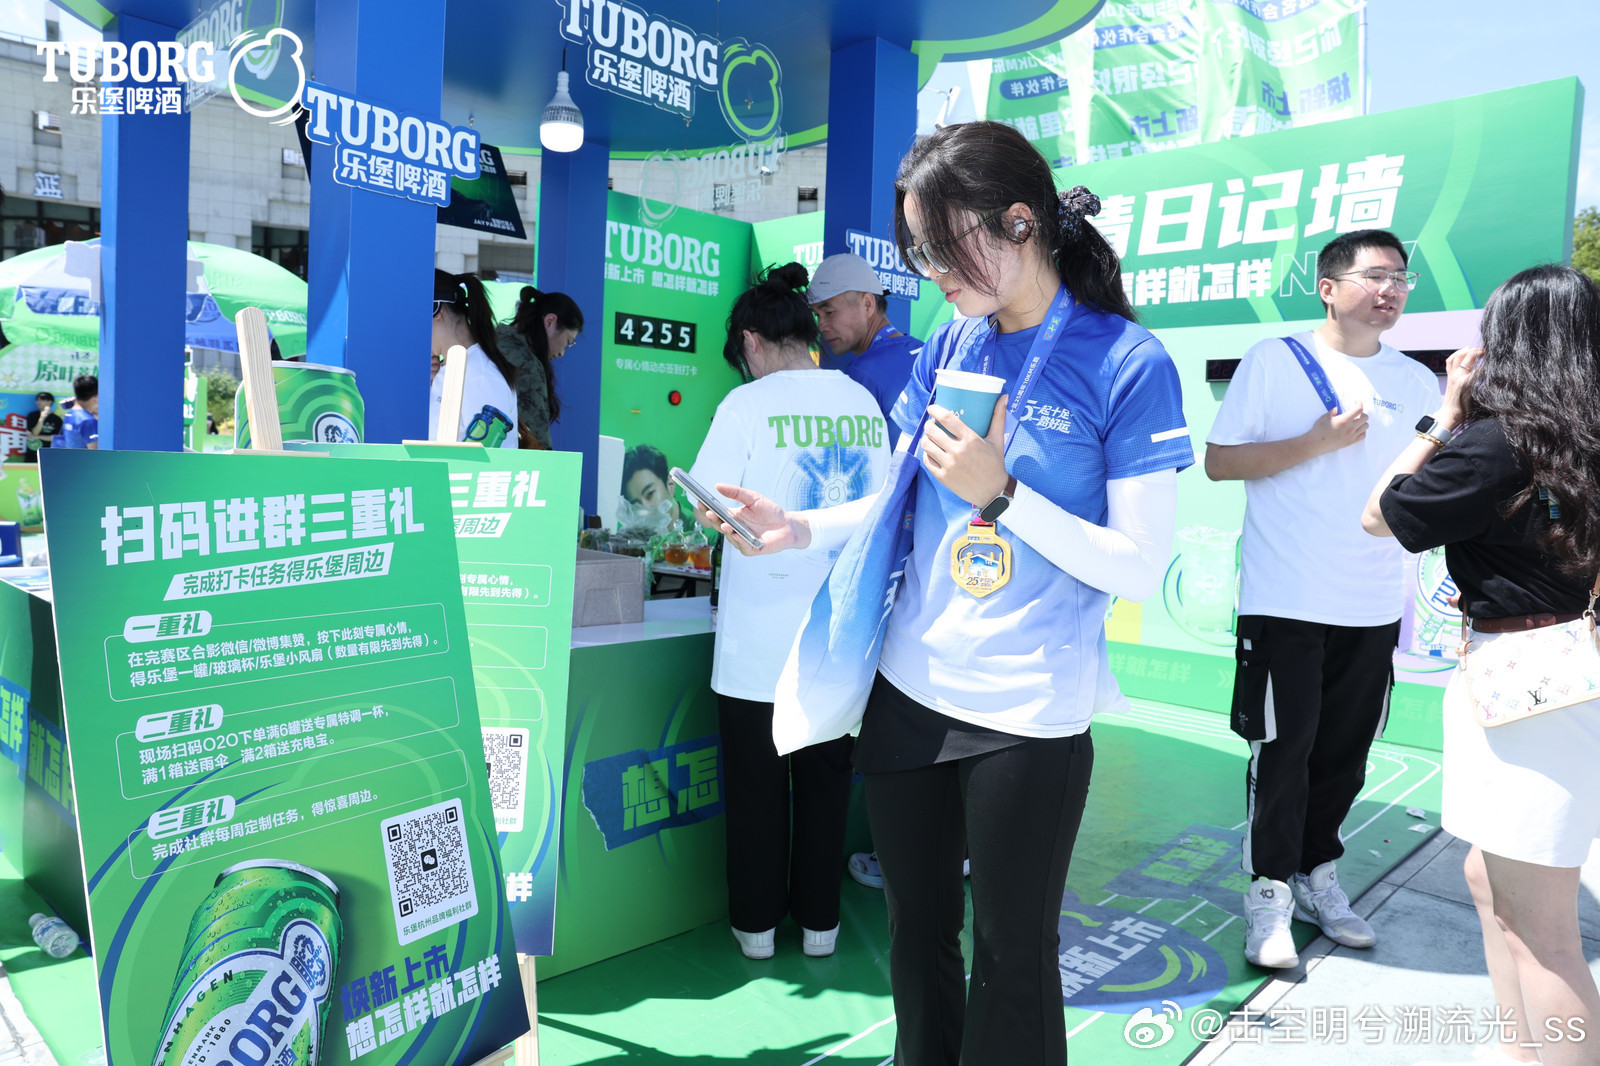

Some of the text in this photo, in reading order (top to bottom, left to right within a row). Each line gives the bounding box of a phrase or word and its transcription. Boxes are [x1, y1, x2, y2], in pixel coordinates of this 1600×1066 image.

[566, 0, 718, 85] TUBORG
[592, 49, 691, 111] 乐堡啤酒
[307, 86, 476, 174] TUBORG
[341, 149, 446, 201] 乐堡啤酒
[604, 262, 645, 285] 新上市
[605, 220, 720, 277] TUBORG
[874, 269, 918, 297] 堡啤酒
[620, 318, 691, 348] 4255
[768, 415, 883, 448] TUBORG
[101, 487, 425, 566] 扫码进群三重礼
[183, 548, 386, 596] 完成打卡任务得乐堡周边
[132, 612, 203, 638] 一重礼
[143, 706, 215, 740] 二重礼
[142, 733, 335, 785] 满1箱送雨伞 满2箱送充电宝。
[622, 745, 720, 831] 想怎
[155, 798, 227, 836] 三重礼
[402, 901, 473, 936] 乐堡杭州品牌福利社群
[340, 944, 450, 1023] 换新上市
[345, 953, 503, 1062] 想怎样就怎样
